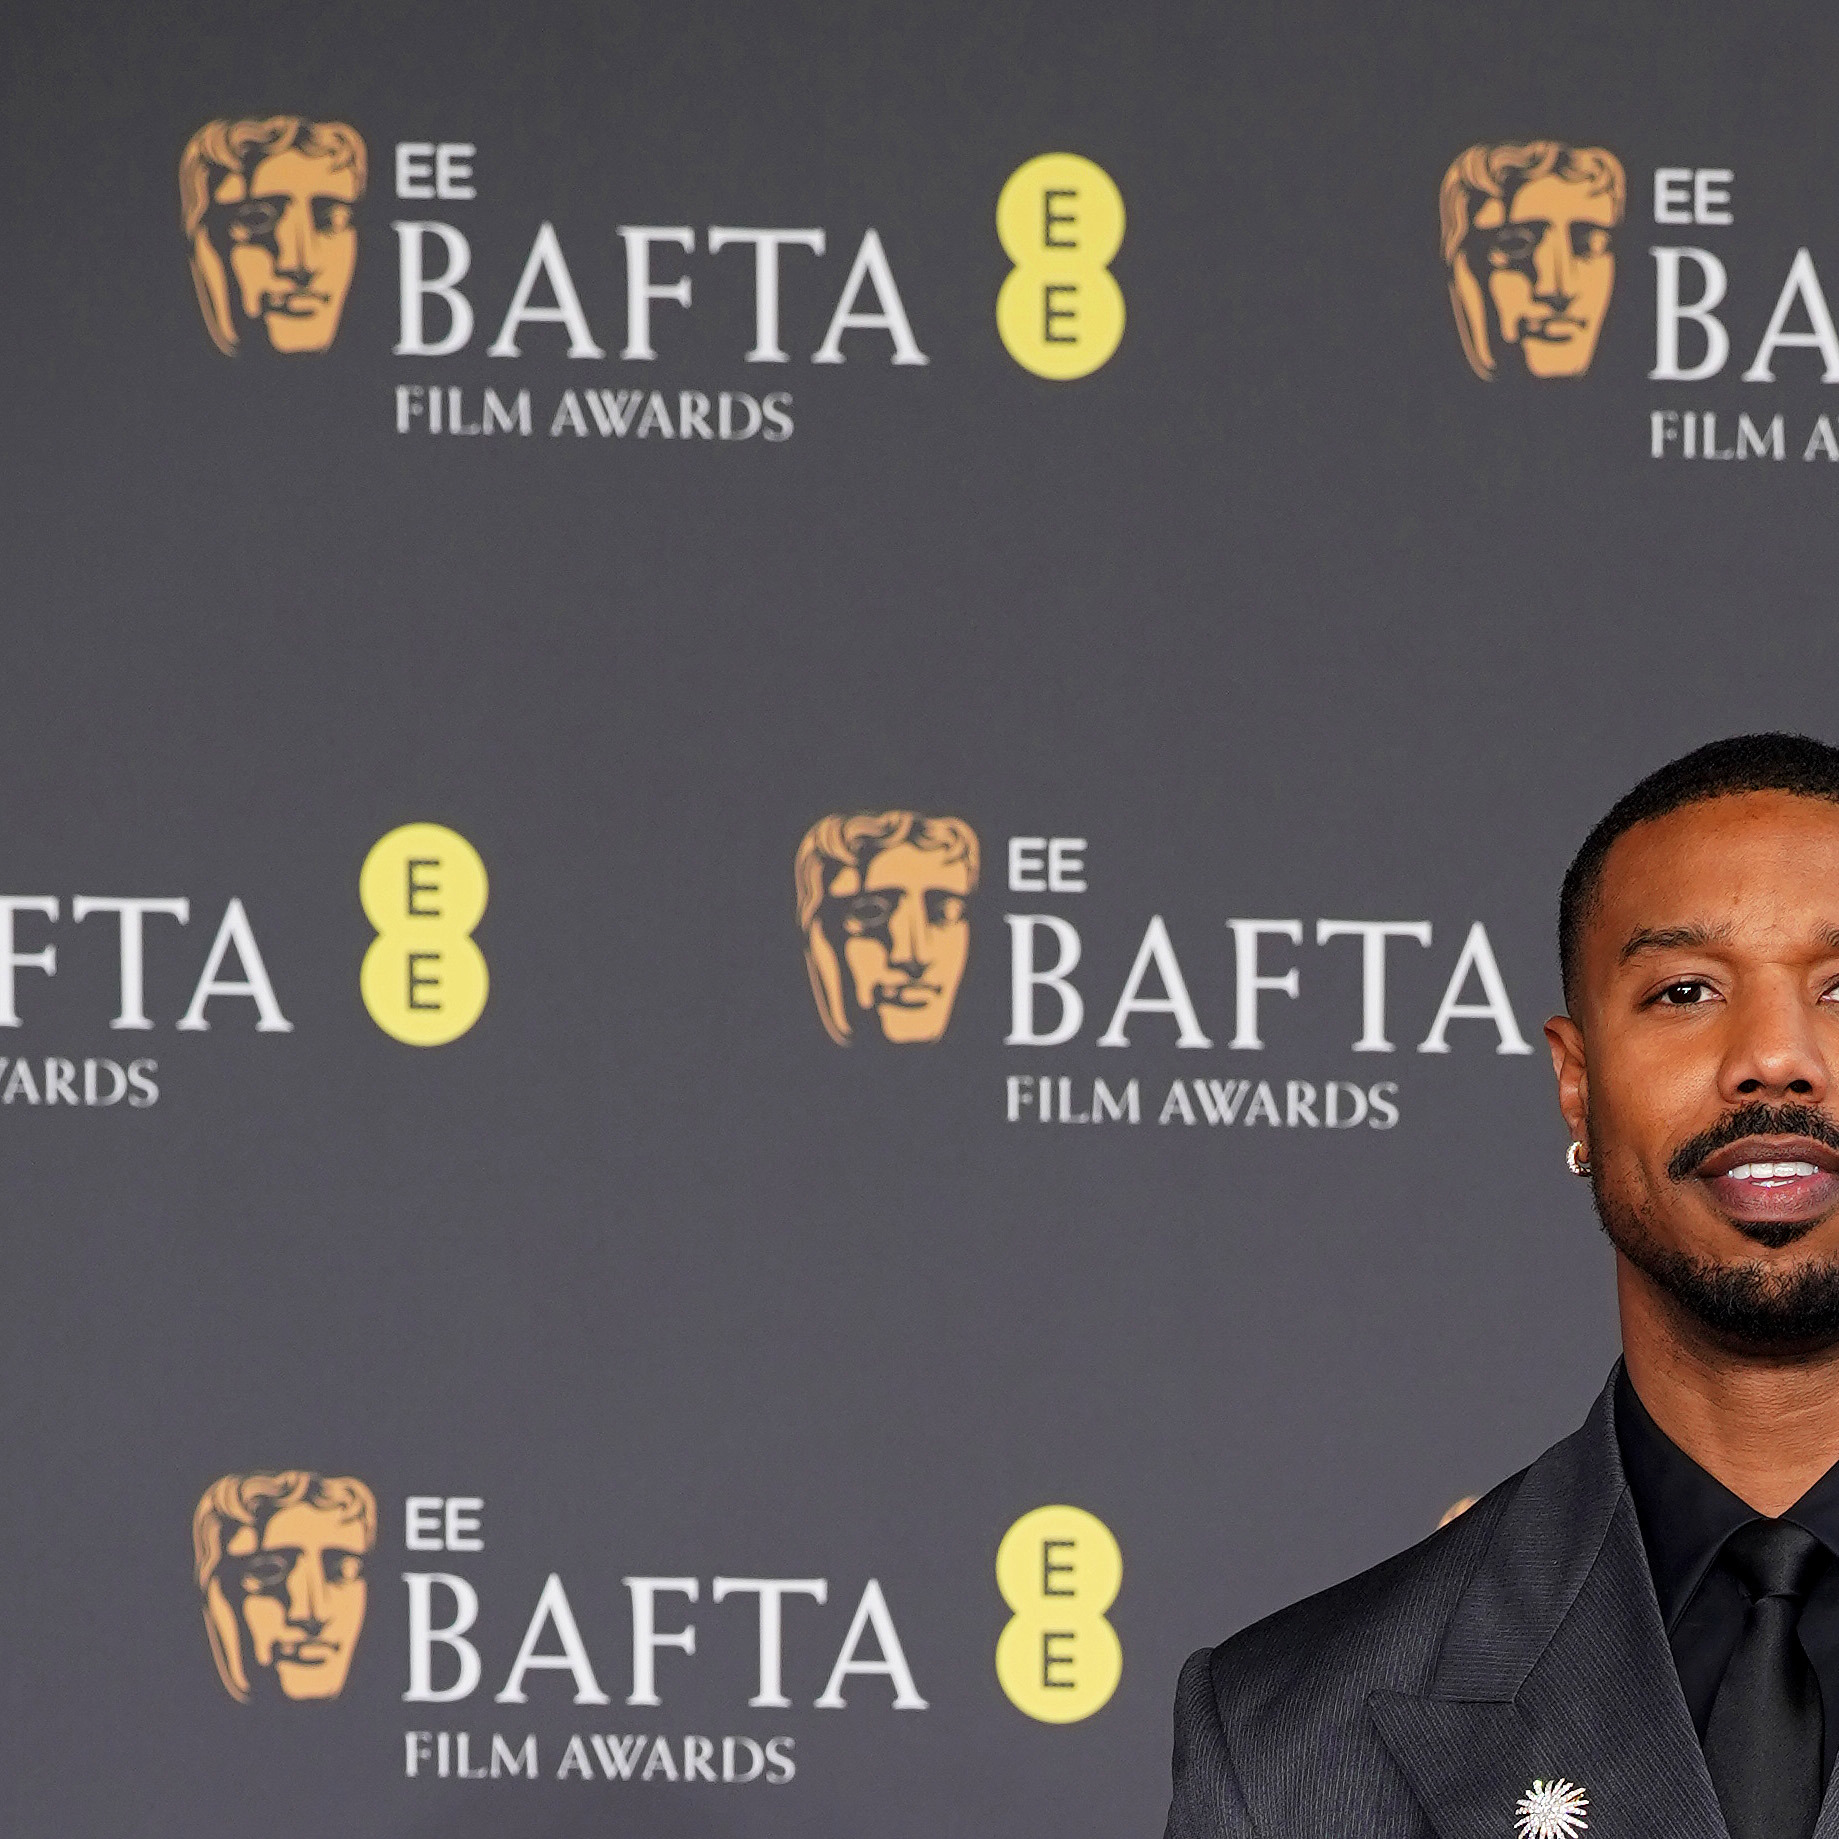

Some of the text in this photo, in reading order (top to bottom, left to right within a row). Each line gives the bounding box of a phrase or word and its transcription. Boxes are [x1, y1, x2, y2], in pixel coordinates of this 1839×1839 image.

[396, 143, 477, 200] EE
[1654, 168, 1734, 225] EE
[394, 222, 928, 365] BAFTA
[396, 385, 794, 440] FILM AWARDS
[1651, 411, 1785, 460] FILM
[1008, 837, 1088, 893] EE
[1004, 914, 1534, 1055] BAFTA
[0, 1057, 159, 1107] ARDS
[1007, 1075, 1399, 1129] FILM AWARDS
[405, 1496, 484, 1552] EE
[402, 1572, 930, 1710] BAFTA
[405, 1731, 796, 1784] FILM AWARDS
